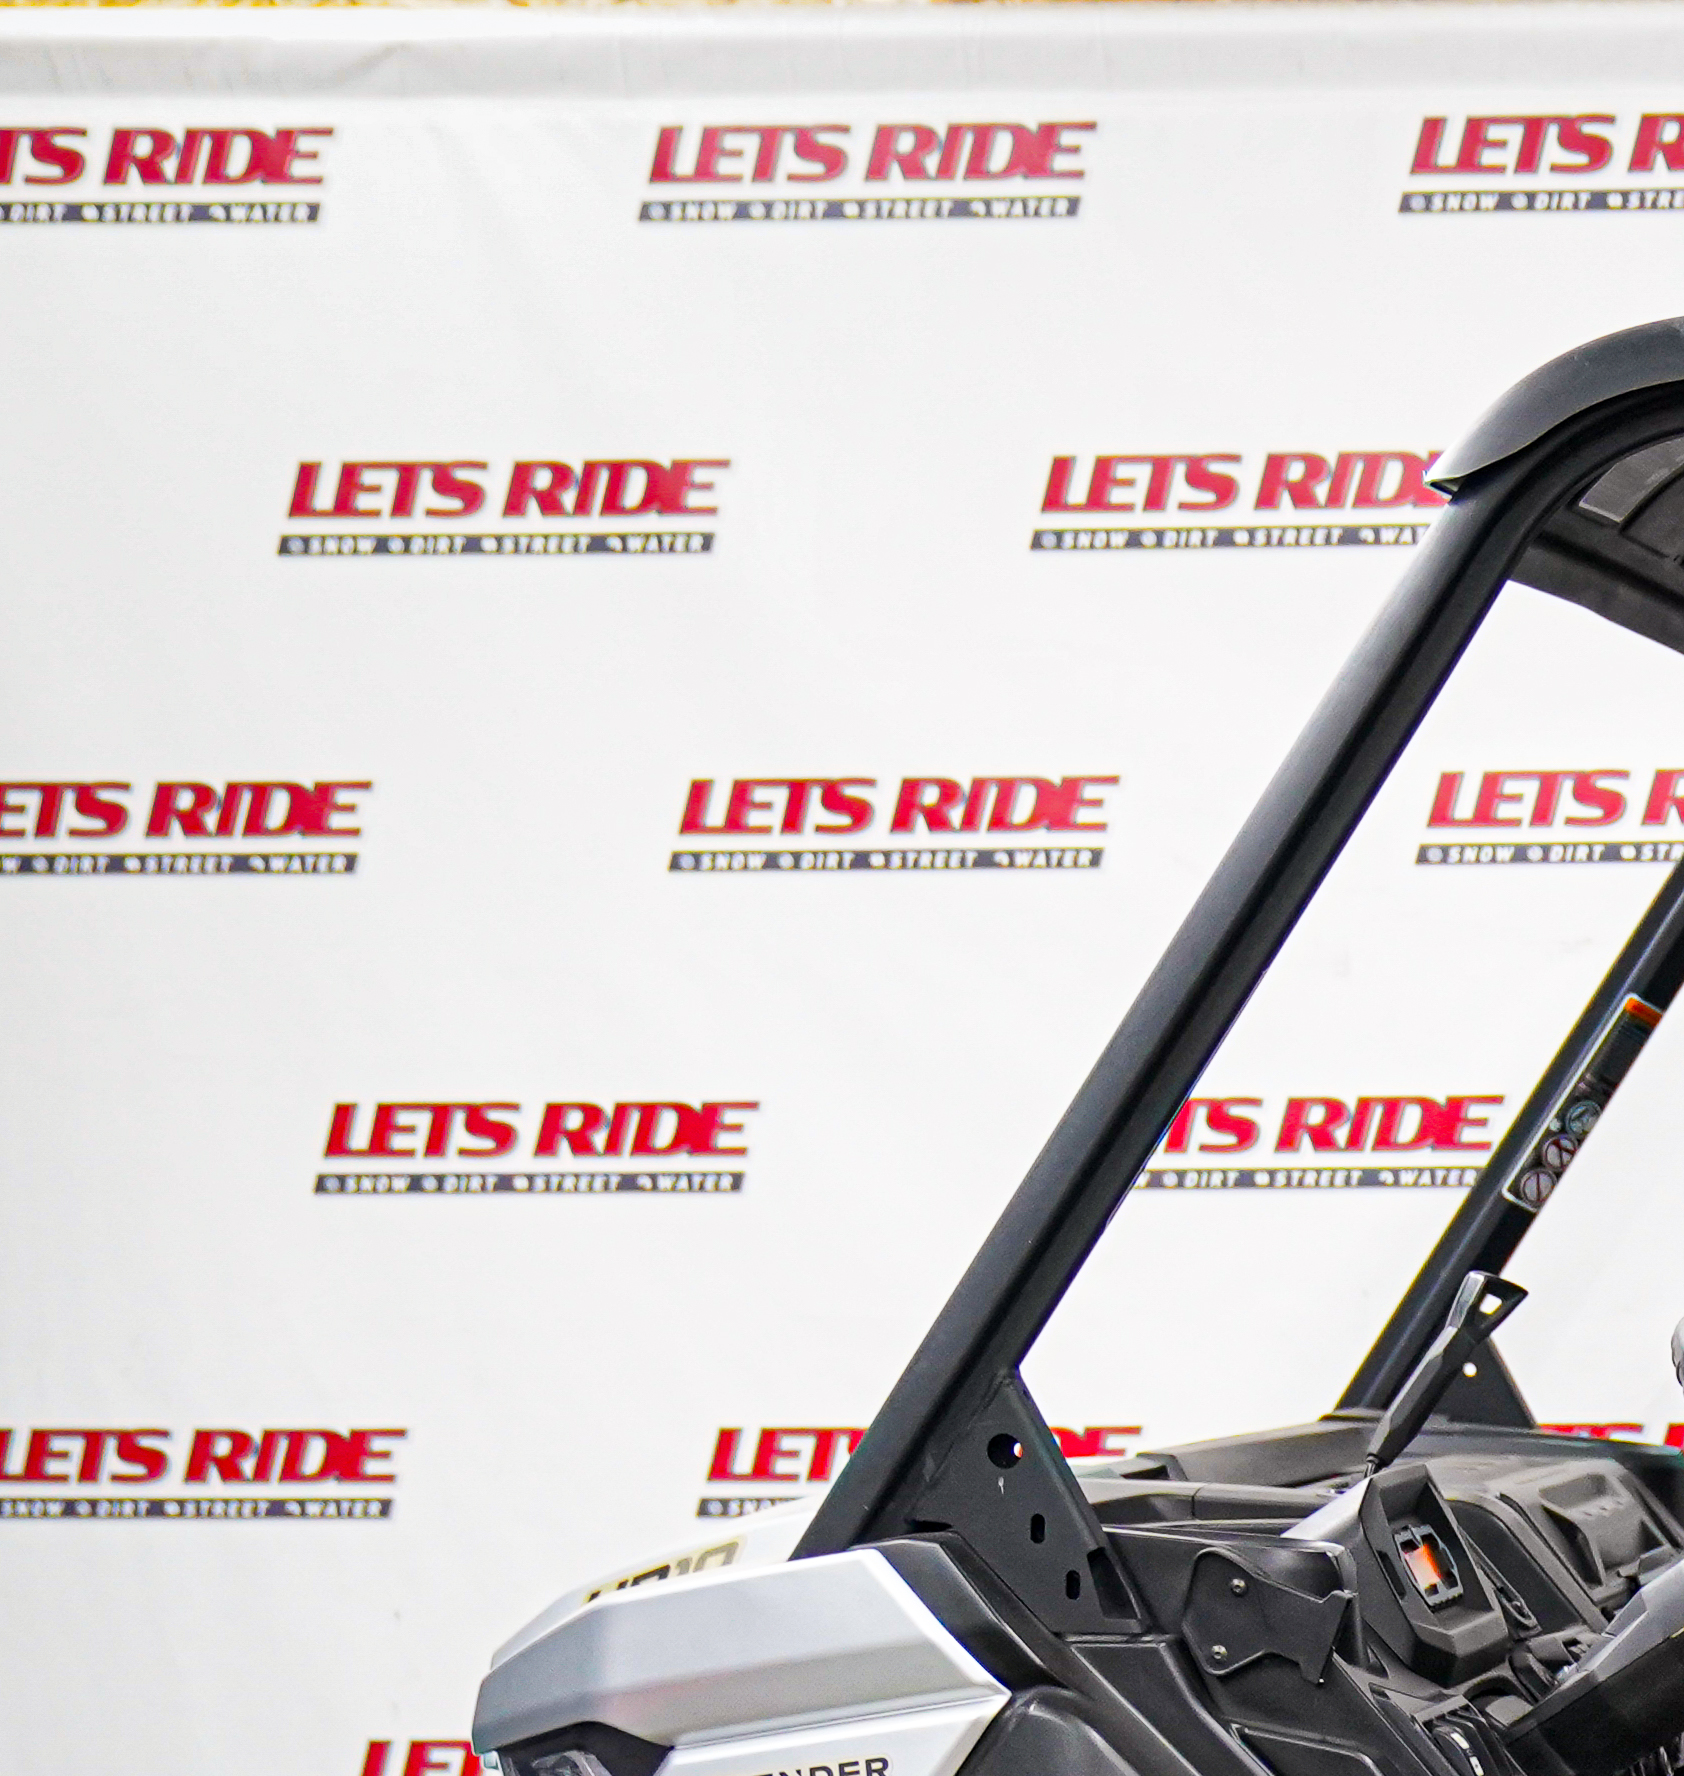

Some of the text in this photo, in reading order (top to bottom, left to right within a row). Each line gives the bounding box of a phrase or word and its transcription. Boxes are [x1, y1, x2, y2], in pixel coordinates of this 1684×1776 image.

[103, 127, 333, 186] RIDE
[649, 121, 1097, 183] LETS RIDE
[1409, 113, 1615, 174] LETS
[1432, 195, 1498, 211] SNOW
[1534, 193, 1591, 210] DIRT
[287, 459, 731, 518] LETS RIDE
[1040, 453, 1241, 513] LETS
[0, 781, 373, 839] ETS RIDE
[678, 775, 1119, 835] LETS RIDE
[1427, 769, 1629, 828] LETS
[1448, 847, 1513, 862] SNOW
[1549, 846, 1605, 862] DIRT
[323, 1101, 759, 1158] LETS RIDE
[1274, 1095, 1505, 1153] RIDE
[183, 1428, 407, 1484] RIDE
[707, 1427, 868, 1482] LET
